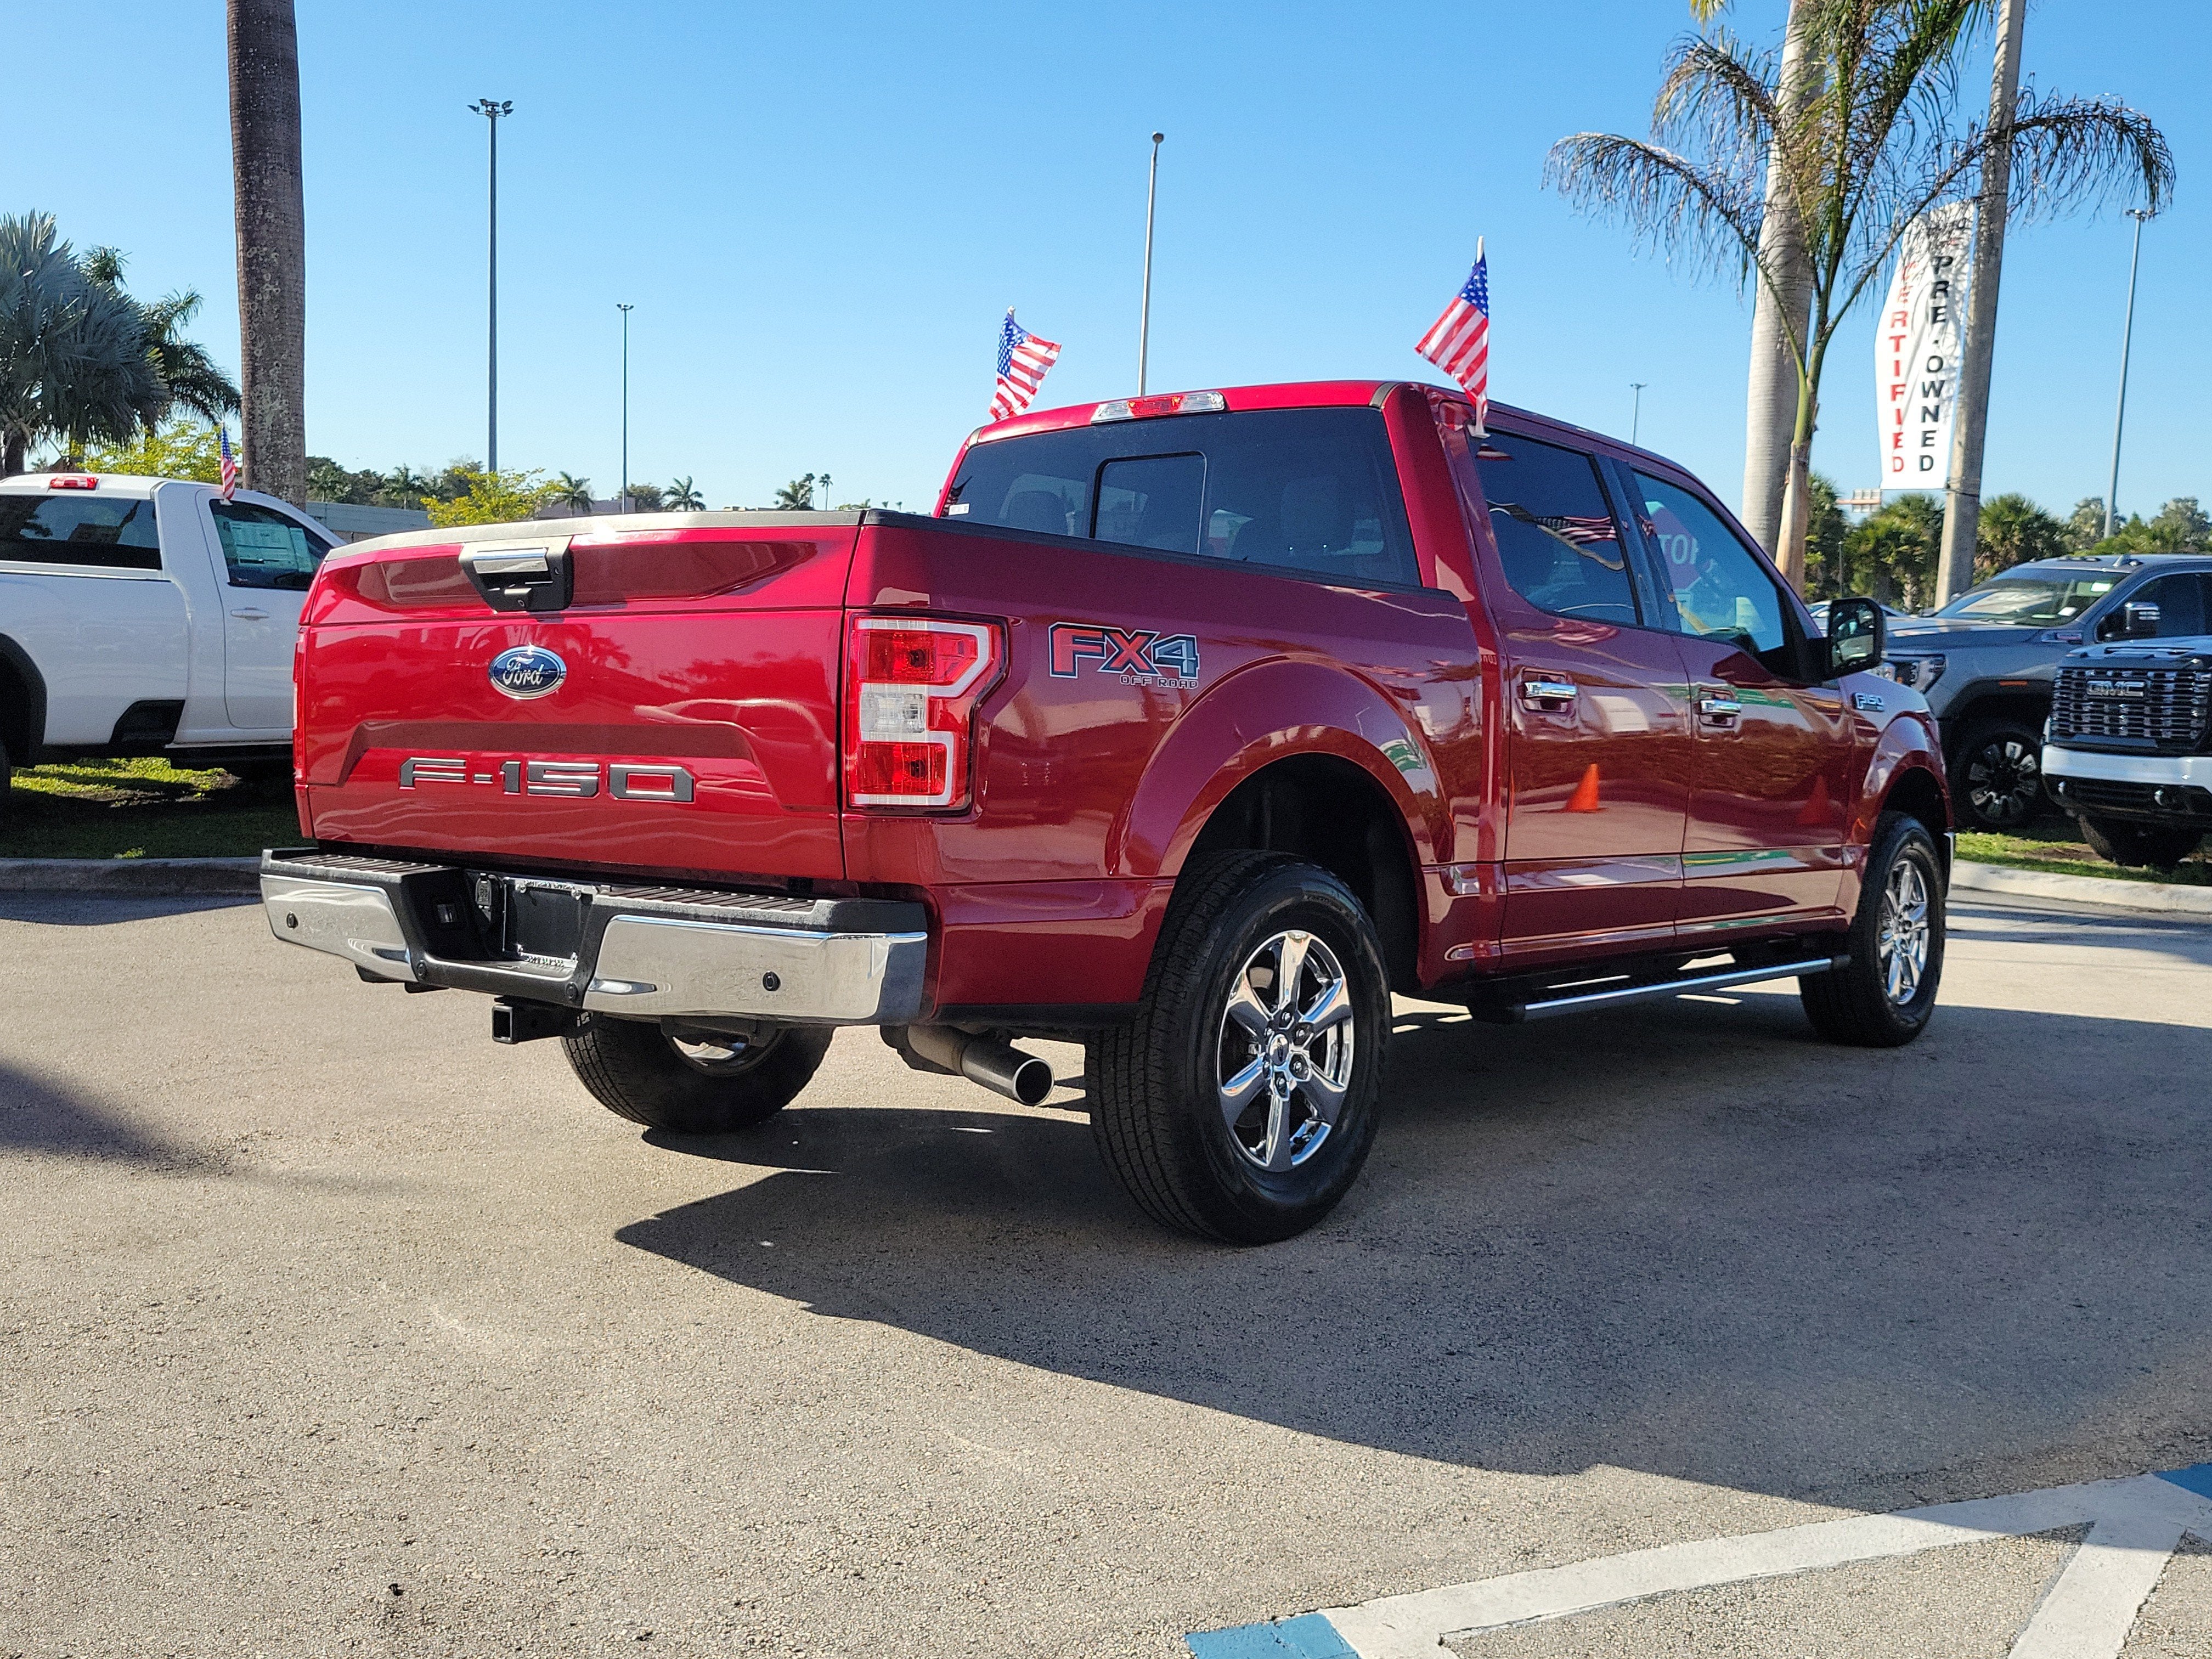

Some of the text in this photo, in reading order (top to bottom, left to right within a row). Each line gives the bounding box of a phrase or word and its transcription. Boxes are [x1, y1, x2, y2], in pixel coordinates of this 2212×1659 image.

[1888, 261, 1918, 473] CERTIFIED
[1048, 621, 1200, 680] FX4
[503, 655, 545, 686] Ford
[1120, 675, 1199, 690] OFF ROAD
[2086, 680, 2145, 698] GMC
[399, 757, 695, 803] F-150
